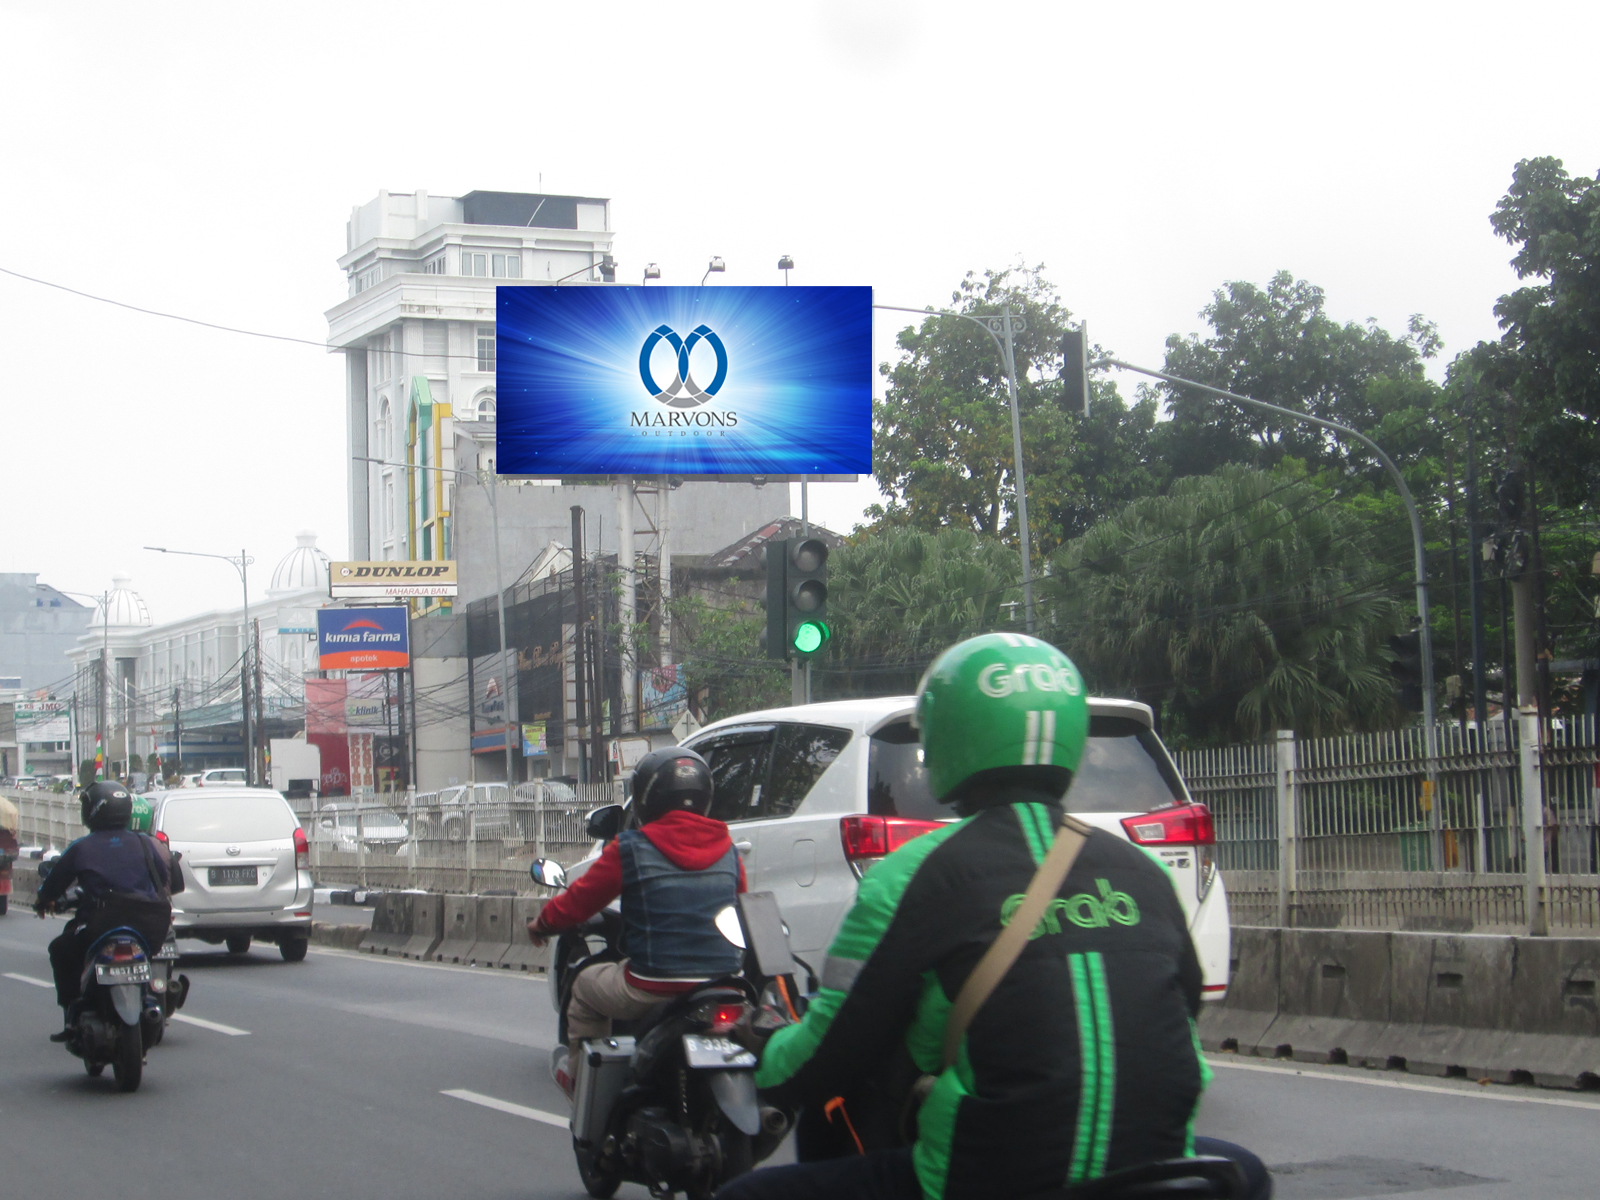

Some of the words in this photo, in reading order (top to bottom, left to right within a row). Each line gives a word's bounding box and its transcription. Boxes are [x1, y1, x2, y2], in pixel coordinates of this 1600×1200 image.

[630, 411, 738, 427] MARVONS
[354, 566, 449, 578] DUNLOP
[385, 588, 429, 596] MAHARAJA
[431, 587, 448, 595] BAN
[325, 632, 360, 643] kimia
[363, 631, 401, 643] farma
[350, 654, 378, 664] apotek
[977, 656, 1081, 698] Grab
[355, 706, 379, 715] klinik
[131, 803, 149, 815] rab
[686, 1038, 698, 1053] B
